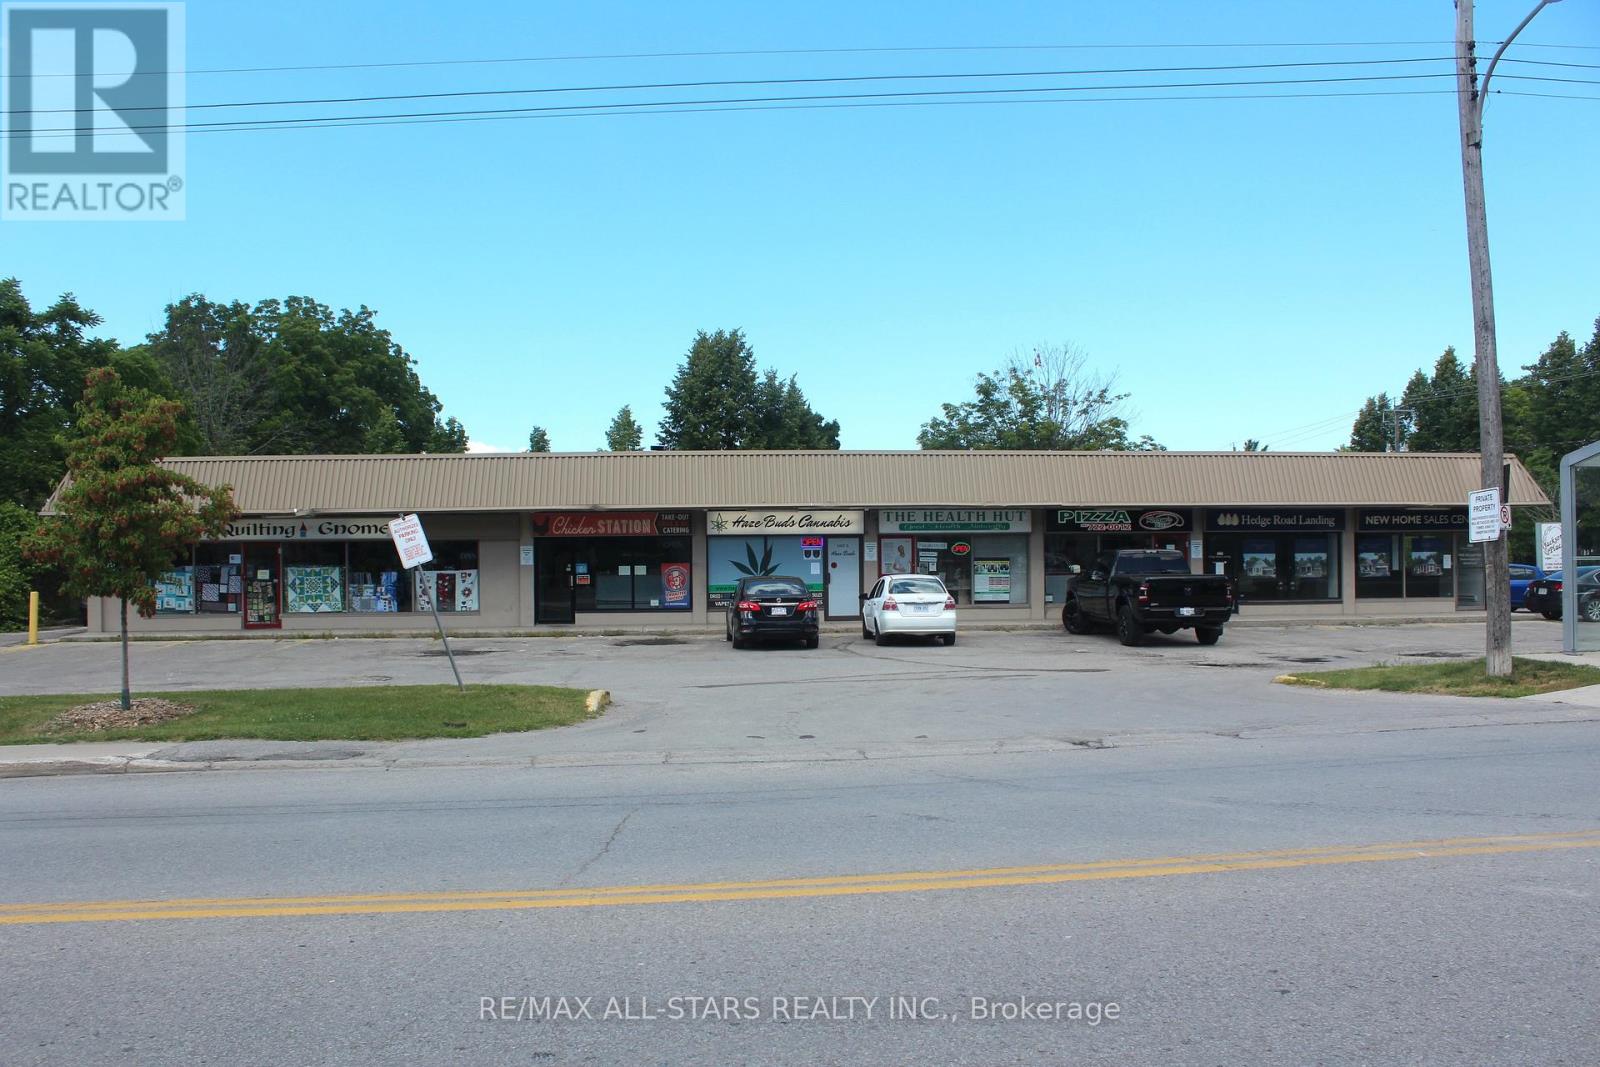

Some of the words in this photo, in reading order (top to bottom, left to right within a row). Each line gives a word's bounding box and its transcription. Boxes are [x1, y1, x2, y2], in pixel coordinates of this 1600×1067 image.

[1475, 493, 1493, 503] PRIVATE
[1473, 504, 1496, 513] PROPERTY
[661, 513, 689, 521] TAKE-OUT
[732, 514, 763, 528] Haze
[763, 514, 796, 528] Buds
[798, 514, 853, 528] Cannabis
[883, 511, 916, 522] THE
[924, 511, 987, 522] HEALTH
[993, 511, 1026, 522] HUT
[1057, 510, 1132, 524] PIZZA
[1241, 515, 1271, 528] Hedge
[1273, 515, 1296, 526] Road
[1299, 515, 1336, 528] Landing
[1366, 516, 1391, 526] NEW
[1392, 515, 1422, 525] HOME
[1423, 515, 1449, 525] SALES
[1450, 515, 1469, 525] CEN
[552, 516, 597, 535] Chicken
[597, 519, 651, 534] STATION
[662, 526, 690, 534] CATERING
[399, 529, 419, 539] PARKING
[803, 537, 822, 546] OPEN
[953, 544, 969, 553] OPEN
